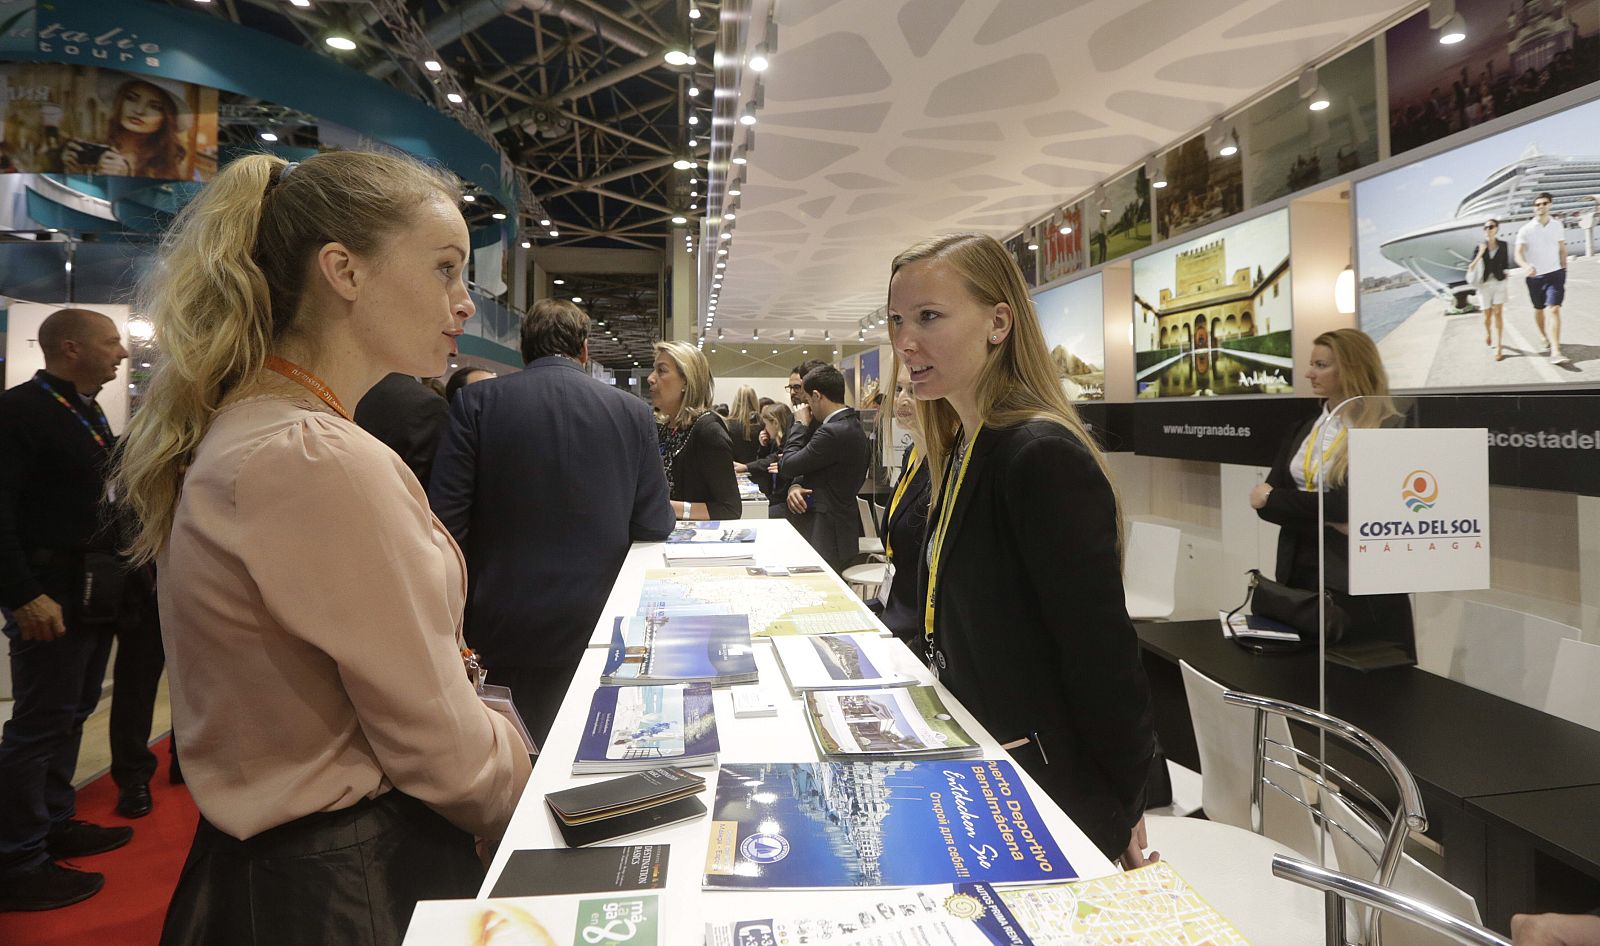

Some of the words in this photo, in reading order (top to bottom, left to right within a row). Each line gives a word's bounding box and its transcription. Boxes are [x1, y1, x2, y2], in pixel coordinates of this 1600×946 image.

[39, 41, 161, 67] tours
[1163, 423, 1251, 438] www.turgranada.es
[1359, 521, 1415, 537] COSTA
[1418, 520, 1448, 535] DEL
[1451, 519, 1481, 533] SOL
[1359, 541, 1482, 553] MÁLAGA
[929, 791, 950, 825] Открой
[942, 770, 980, 838] Entdecken
[969, 844, 999, 869] Sie
[971, 766, 1024, 861] Benalmádena
[984, 760, 1012, 796] Puerto
[1006, 800, 1053, 872] Deportivo
[939, 826, 955, 845] для
[637, 846, 653, 884] DESTINATION
[947, 845, 971, 877] себя!!!
[974, 884, 995, 905] AUTOS
[988, 904, 1009, 927] PRIMA
[1003, 925, 1024, 945] RENT
